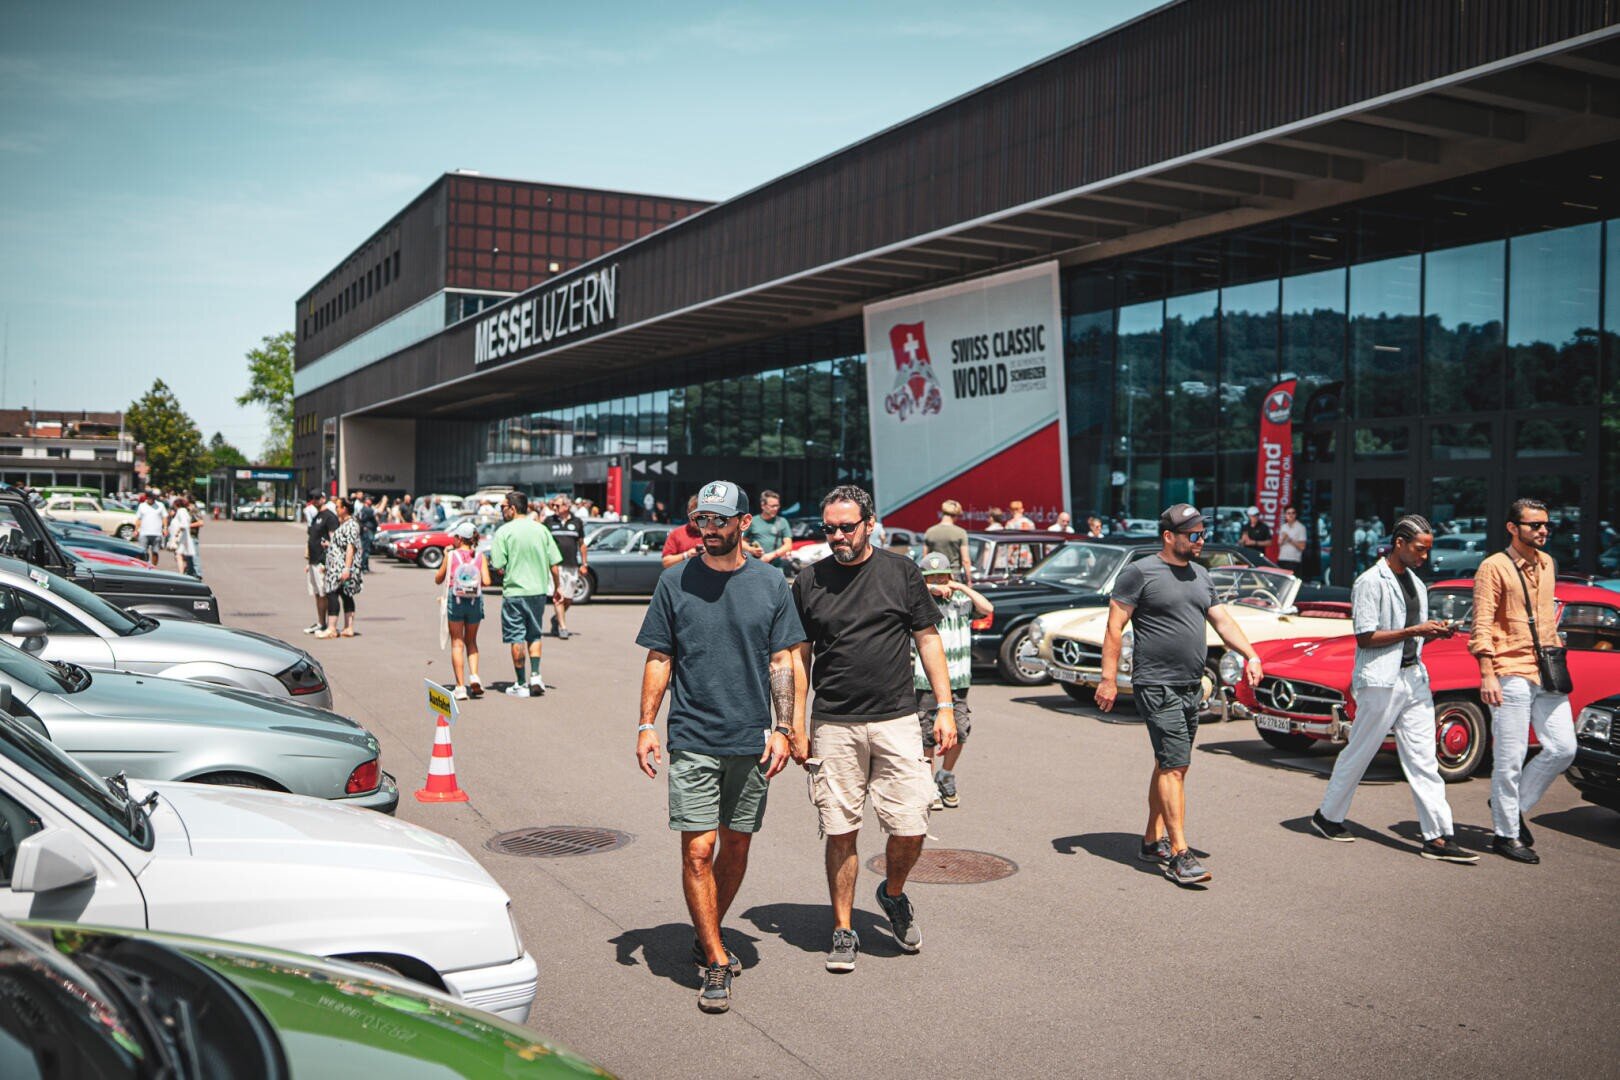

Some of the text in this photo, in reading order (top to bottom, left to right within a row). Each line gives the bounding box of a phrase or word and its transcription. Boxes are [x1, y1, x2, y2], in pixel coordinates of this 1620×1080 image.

[475, 263, 620, 365] MESSELUZERN
[951, 324, 1046, 365] SWISS CLASSIC
[952, 363, 1008, 399] WORLD
[359, 472, 396, 483] FORUM
